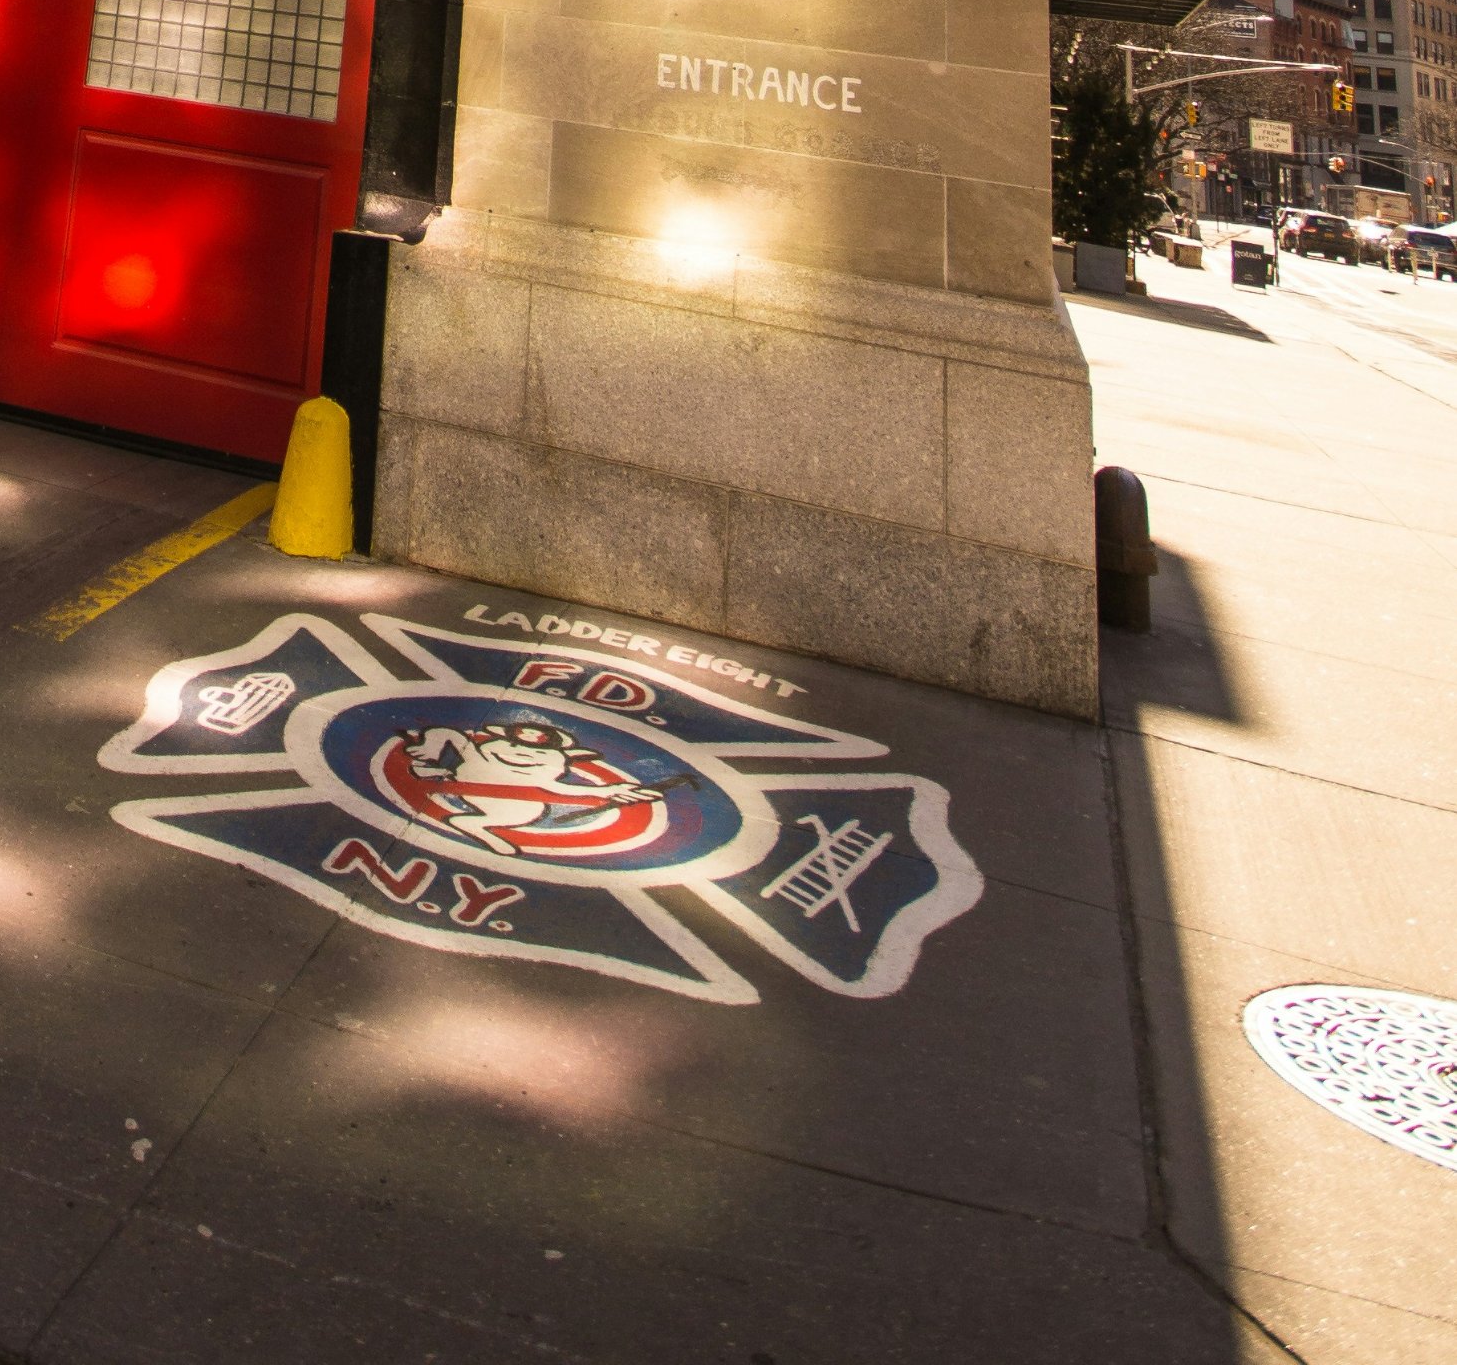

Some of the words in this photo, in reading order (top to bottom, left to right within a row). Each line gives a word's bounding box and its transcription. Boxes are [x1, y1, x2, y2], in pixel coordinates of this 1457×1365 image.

[656, 53, 862, 114] ENTRANCE
[464, 604, 663, 657] LADDER
[665, 643, 809, 699] EIGHT
[512, 661, 668, 726] F.D.
[322, 837, 526, 932] N.Y.
